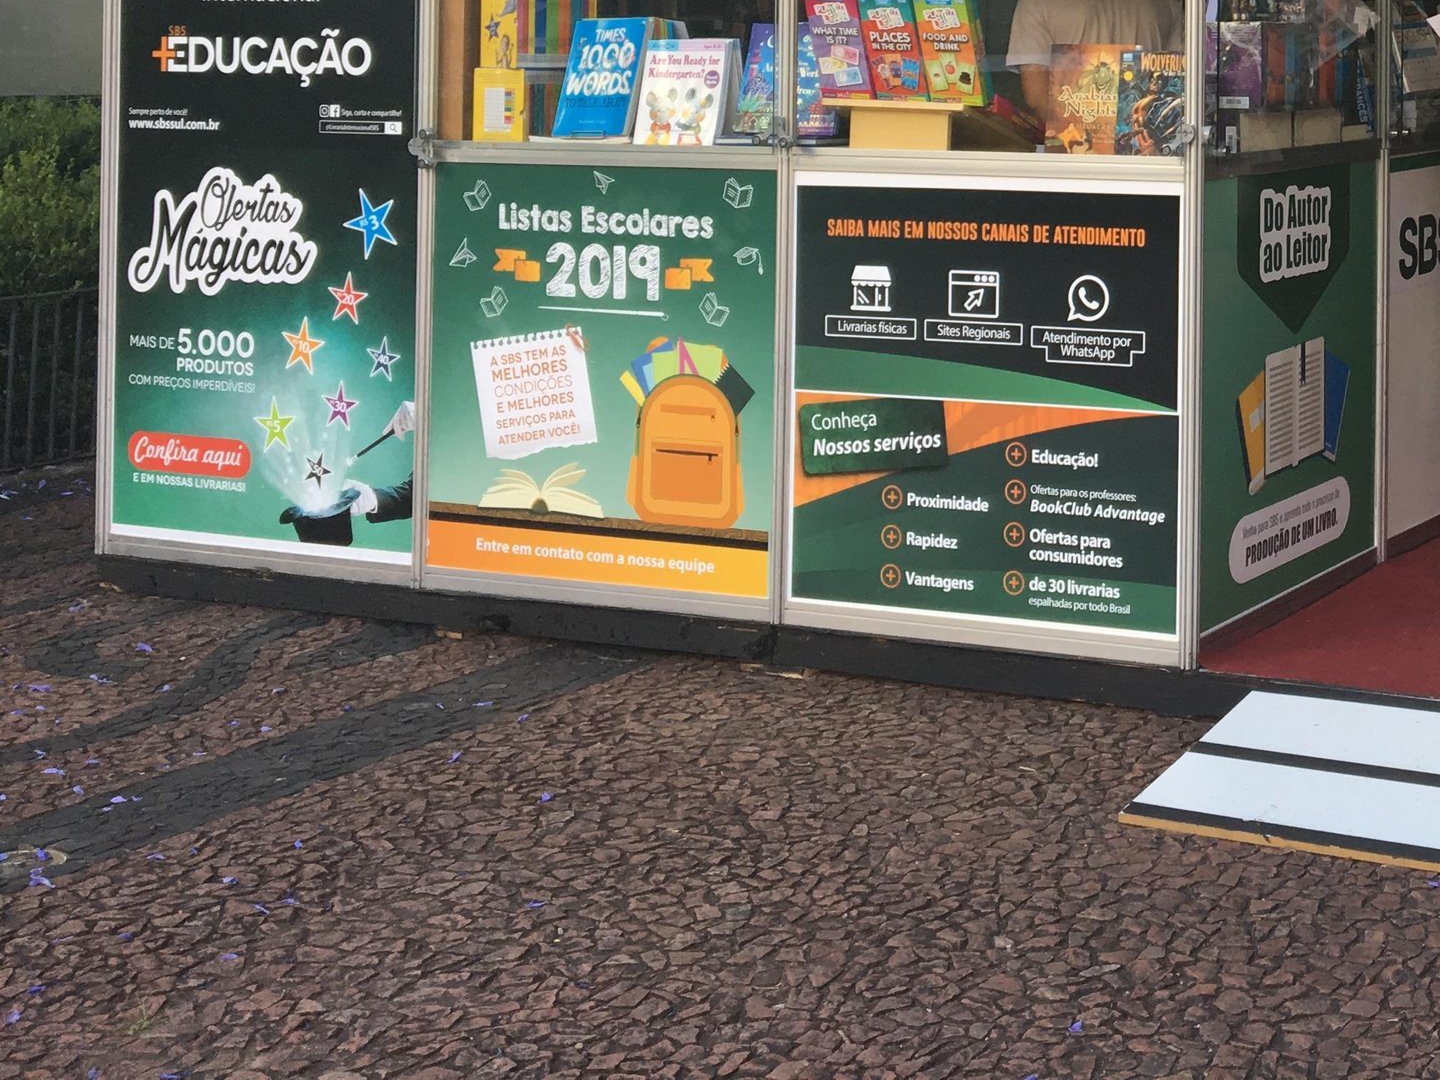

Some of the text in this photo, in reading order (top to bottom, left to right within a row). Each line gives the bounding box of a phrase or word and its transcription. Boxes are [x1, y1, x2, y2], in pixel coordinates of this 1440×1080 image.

[812, 26, 859, 36] WHAT TIME
[825, 35, 848, 45] IS IT?
[869, 31, 911, 43] PLACES
[923, 32, 969, 42] FOOD AND
[872, 42, 912, 52] IN THE CITY
[934, 42, 961, 52] DRINK
[650, 54, 721, 67] Are You Ready for
[566, 71, 632, 97] WORDS
[648, 67, 706, 80] Kindergarten?
[128, 117, 220, 130] www.sbssul.com.br
[200, 175, 296, 231] Ofertas
[1263, 189, 1329, 233] Do Autor
[368, 214, 380, 231] 3
[498, 203, 715, 240] Listas Escolares
[133, 198, 313, 288] Mágicas
[827, 218, 1146, 248] SAIBA MAIS EM NOSSOS CANAIS DE ATENDIMENTO
[1263, 232, 1329, 274] ao Leitor
[545, 241, 661, 302] 2019
[340, 293, 354, 306] 20
[837, 319, 908, 336] Livrarias físicas
[937, 323, 1011, 343] Sites Regionais
[129, 328, 255, 358] MAIS DE 5.000
[297, 340, 310, 353] 10
[1042, 330, 1132, 350] Atendimento por
[489, 344, 568, 367] A SBS TEM AS
[1059, 343, 1116, 362] WhatsApp
[176, 357, 255, 377] PRODUTOS
[491, 358, 569, 383] MELHORES
[128, 373, 256, 394] COM PREÇOS IMPERDÍVEIS!
[494, 375, 574, 398] CONDIÇÕES
[333, 402, 347, 413] 30
[496, 391, 575, 414] E MELHORES
[496, 408, 577, 431] SERVIÇOS PARA
[811, 411, 878, 433] Conheça
[498, 422, 581, 446] ATENDER VOCÊ!
[813, 432, 942, 457] Nossos serviços
[133, 437, 243, 469] Confira aqui
[1031, 449, 1099, 470] Educação!
[132, 472, 246, 493] E EM NOSSAS LIVRARIAS!
[906, 491, 990, 514] Proximidade
[1030, 483, 1137, 504] Ofertas para os professores:
[1030, 498, 1166, 526] BookClub Advantage
[905, 531, 958, 551] Rapidez
[1029, 528, 1112, 552] Ofertas para
[1245, 527, 1290, 567] PRODUÇÃO
[1291, 523, 1302, 547] DE
[1302, 518, 1315, 541] UM
[1315, 507, 1339, 536] LIVRO.
[475, 536, 715, 575] Entre em contato com a nossa equipe
[1029, 548, 1123, 569] consumidores
[905, 571, 975, 592] Vantagens
[1028, 576, 1121, 599] de 30 livrarias
[1028, 596, 1132, 615] espalhadas por todo Brasil
